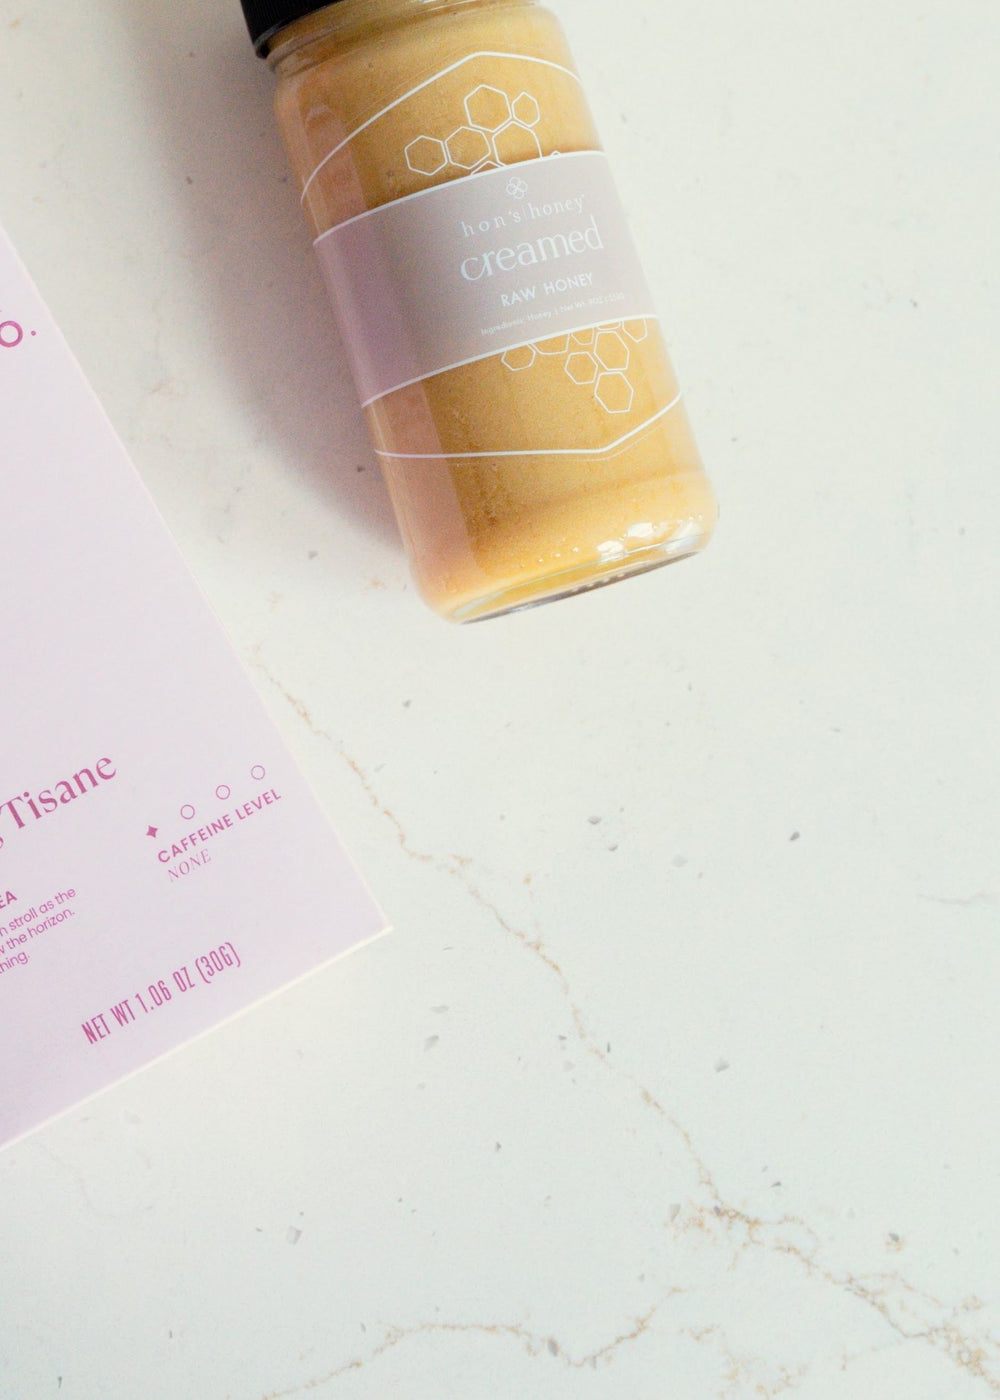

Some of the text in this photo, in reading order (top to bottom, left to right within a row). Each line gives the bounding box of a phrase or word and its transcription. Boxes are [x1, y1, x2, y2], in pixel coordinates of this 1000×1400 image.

[528, 197, 583, 219] honey
[460, 215, 604, 281] creamed
[501, 272, 592, 306] RAW HONEY
[157, 788, 281, 863] CAFFEINE LEVEL
[168, 848, 211, 882] NONE
[6, 932, 27, 953] the
[27, 910, 76, 943] horizon.
[9, 908, 38, 937] stroll
[39, 904, 54, 919] as
[54, 887, 76, 908] the
[81, 942, 241, 1044] NET WT 1.06 OZ (30G)
